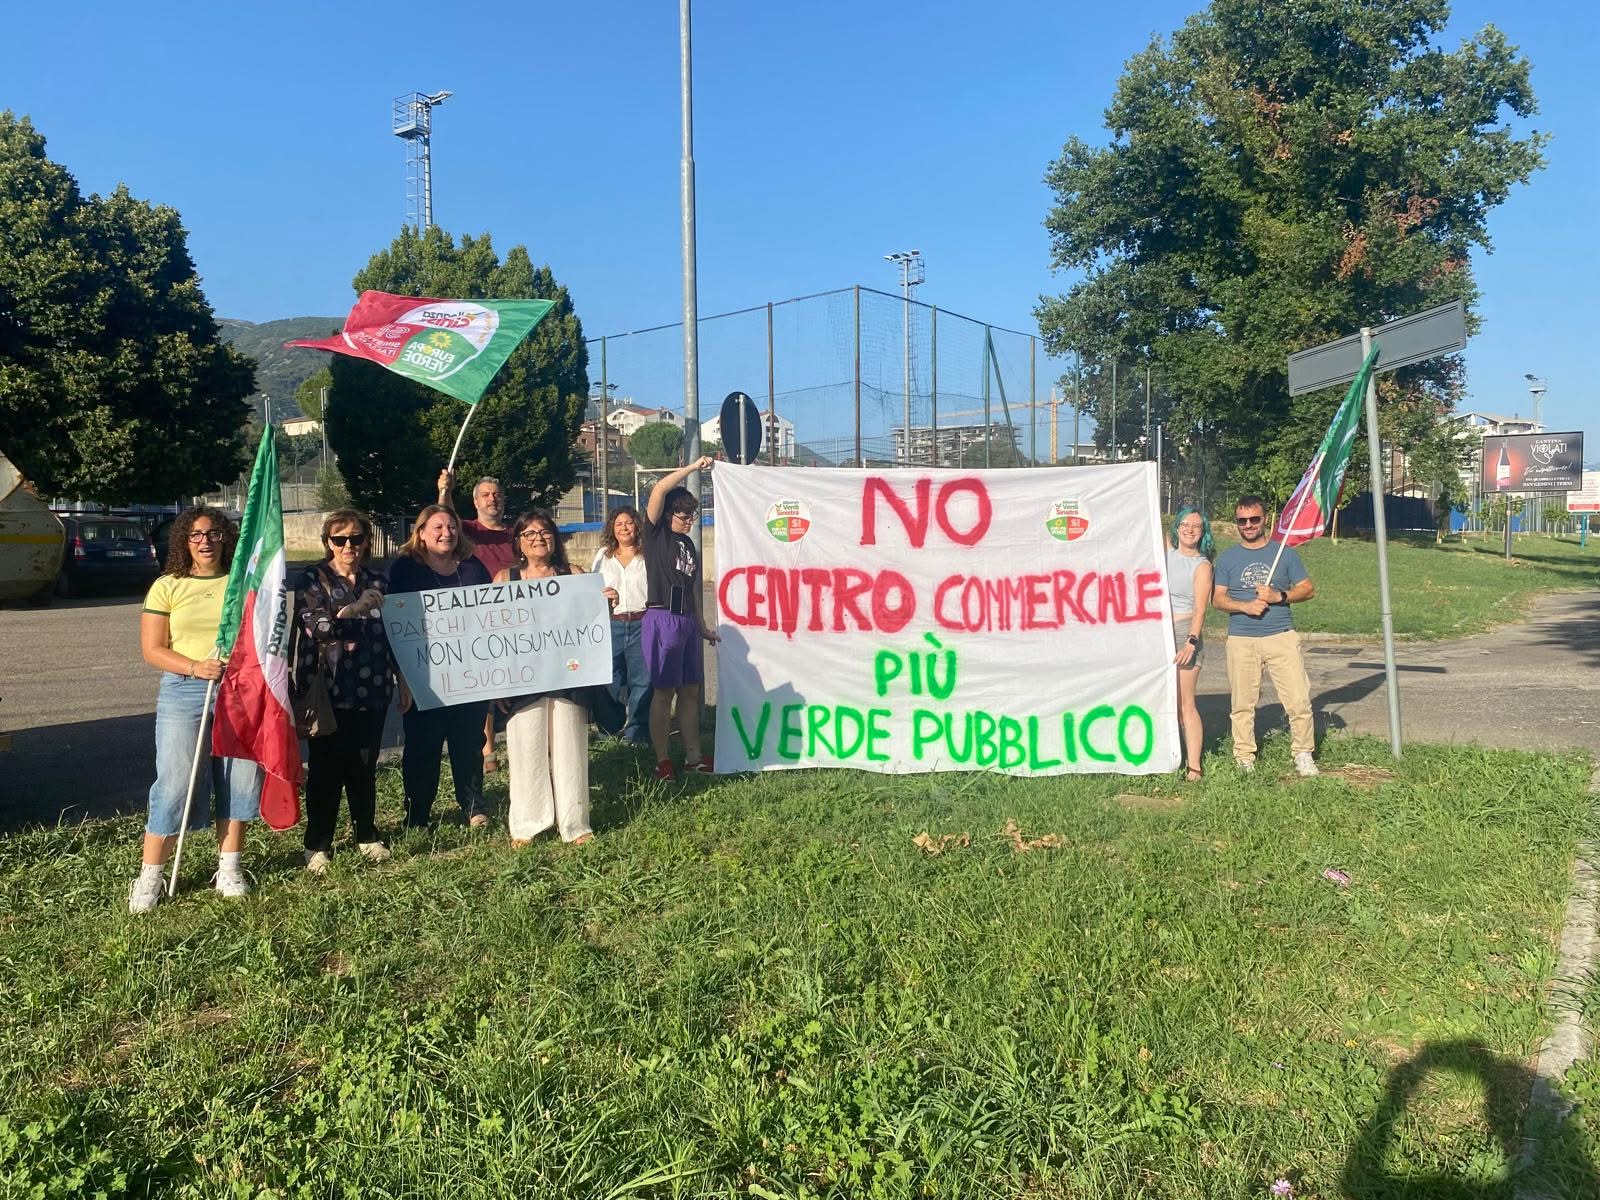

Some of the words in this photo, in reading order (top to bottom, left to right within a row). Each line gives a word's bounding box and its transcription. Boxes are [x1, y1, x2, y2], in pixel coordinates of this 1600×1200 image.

[860, 477, 993, 549] NO
[389, 615, 467, 639] PARCHI
[475, 608, 537, 631] VERDI
[422, 579, 562, 614] REALIZZIAMO
[718, 565, 916, 639] CENTRO
[416, 639, 463, 669] NON
[471, 623, 605, 662] CONSUMIAMO
[874, 632, 957, 700] PIÙ
[441, 673, 457, 695] IL
[463, 665, 535, 690] SUOLO
[731, 701, 892, 761] VERDE
[912, 704, 1154, 771] PUBBLICO
